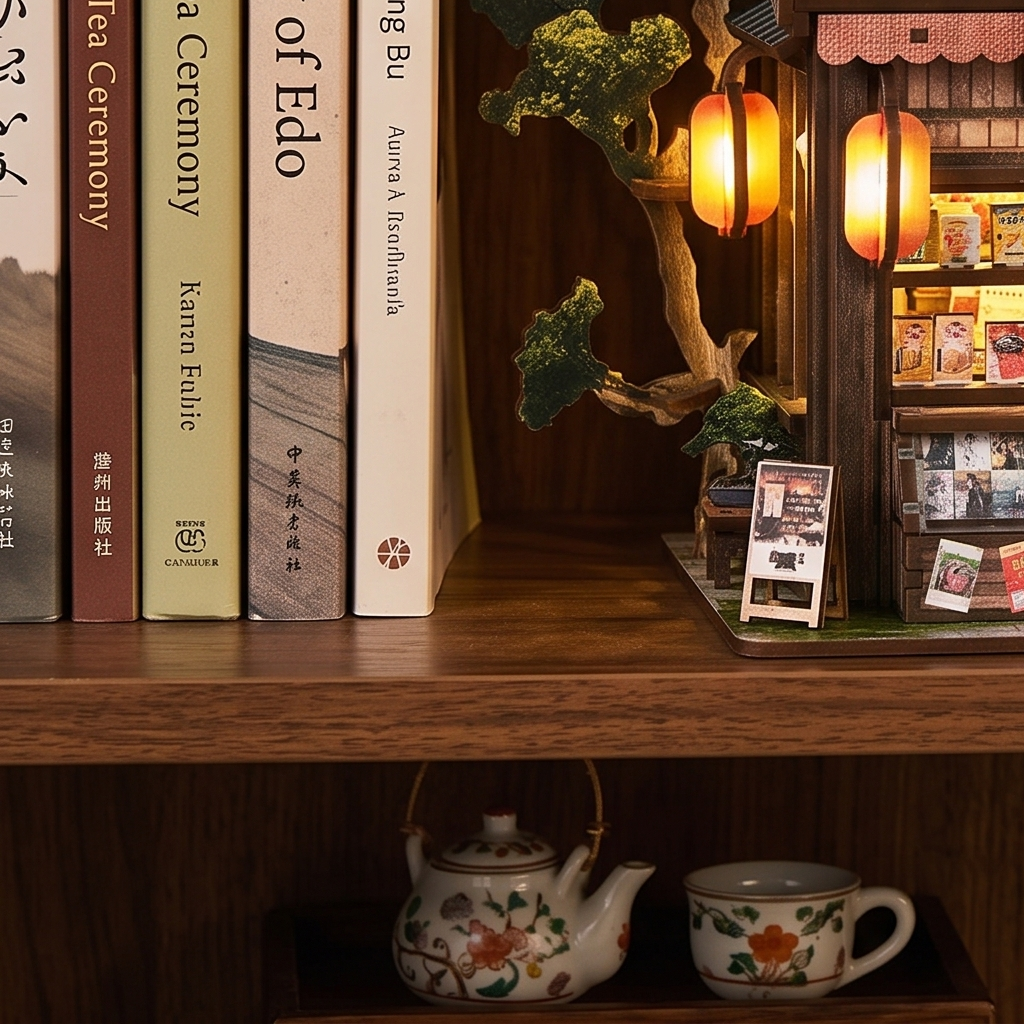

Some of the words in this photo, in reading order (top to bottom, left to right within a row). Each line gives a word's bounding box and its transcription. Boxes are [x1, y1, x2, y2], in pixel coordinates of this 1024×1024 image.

[276, 17, 321, 70] of
[387, 46, 410, 78] Bu
[79, 62, 115, 230] Ceremony
[168, 34, 207, 216] Ceremony
[276, 83, 321, 178] Edo
